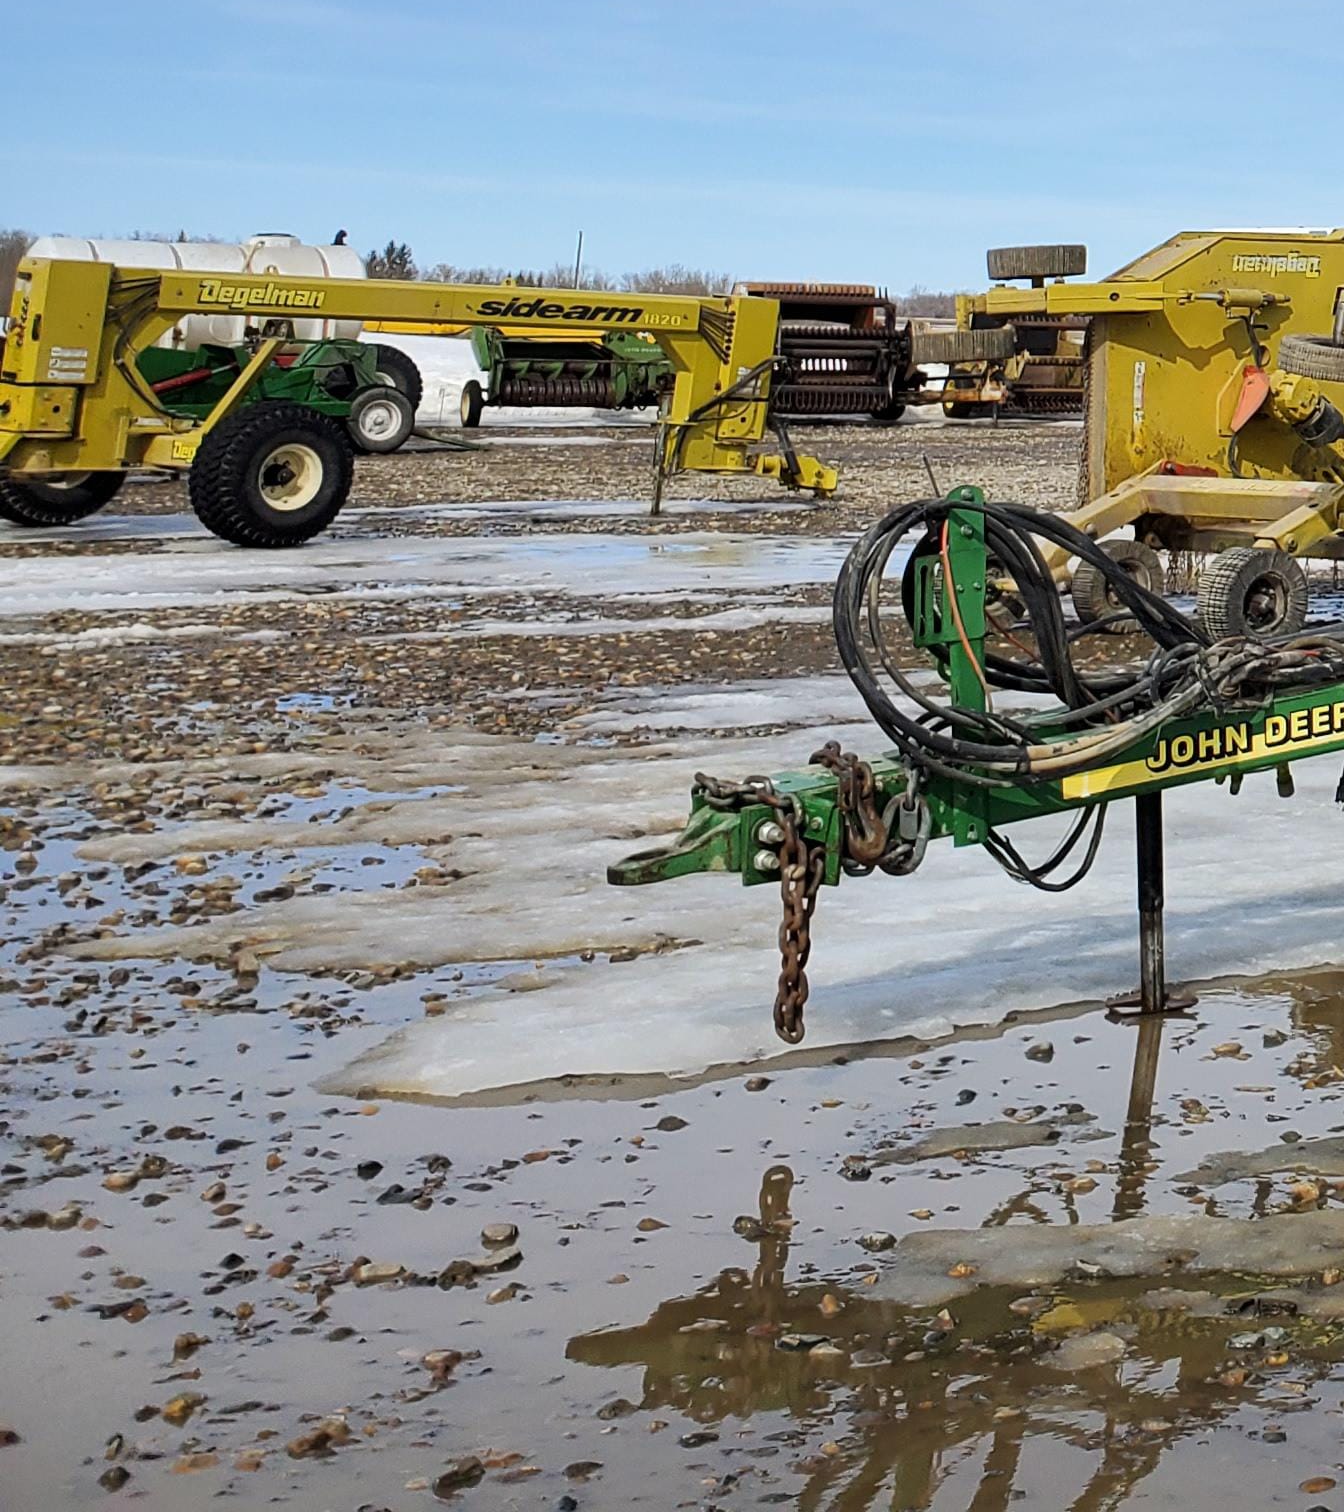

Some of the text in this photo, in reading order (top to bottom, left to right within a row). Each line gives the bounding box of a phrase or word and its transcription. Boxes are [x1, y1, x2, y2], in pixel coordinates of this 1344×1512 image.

[1231, 251, 1320, 278] Degelman
[199, 279, 326, 309] Degelman
[476, 297, 643, 323] sidearm
[643, 313, 681, 326] 1820
[1146, 722, 1253, 771] JOHN
